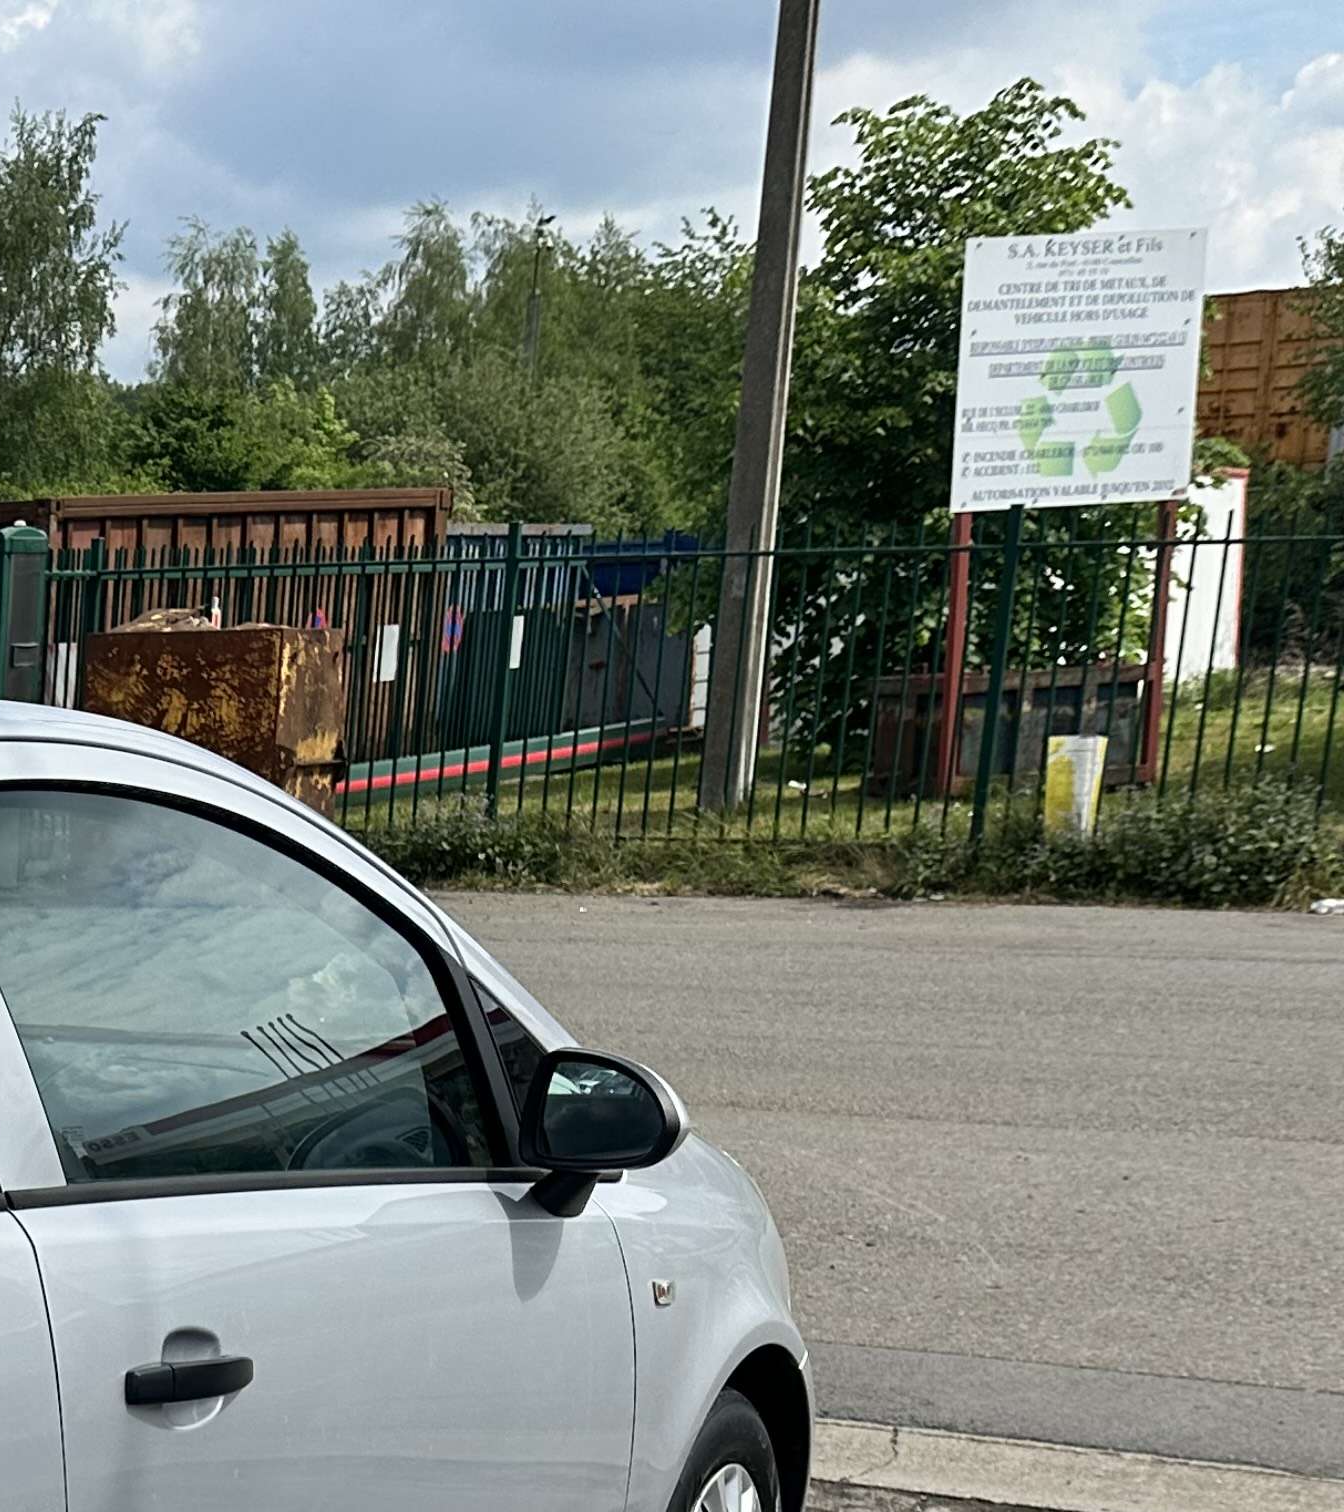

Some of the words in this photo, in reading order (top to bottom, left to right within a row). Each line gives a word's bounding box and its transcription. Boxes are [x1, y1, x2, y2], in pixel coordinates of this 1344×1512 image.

[1008, 243, 1038, 258] S.A.
[1044, 239, 1114, 257] KEYSER
[1118, 241, 1131, 253] et
[1136, 238, 1163, 252] Fils
[998, 280, 1042, 295] CENTRE
[1045, 280, 1060, 293] DE
[1151, 276, 1166, 288] DE
